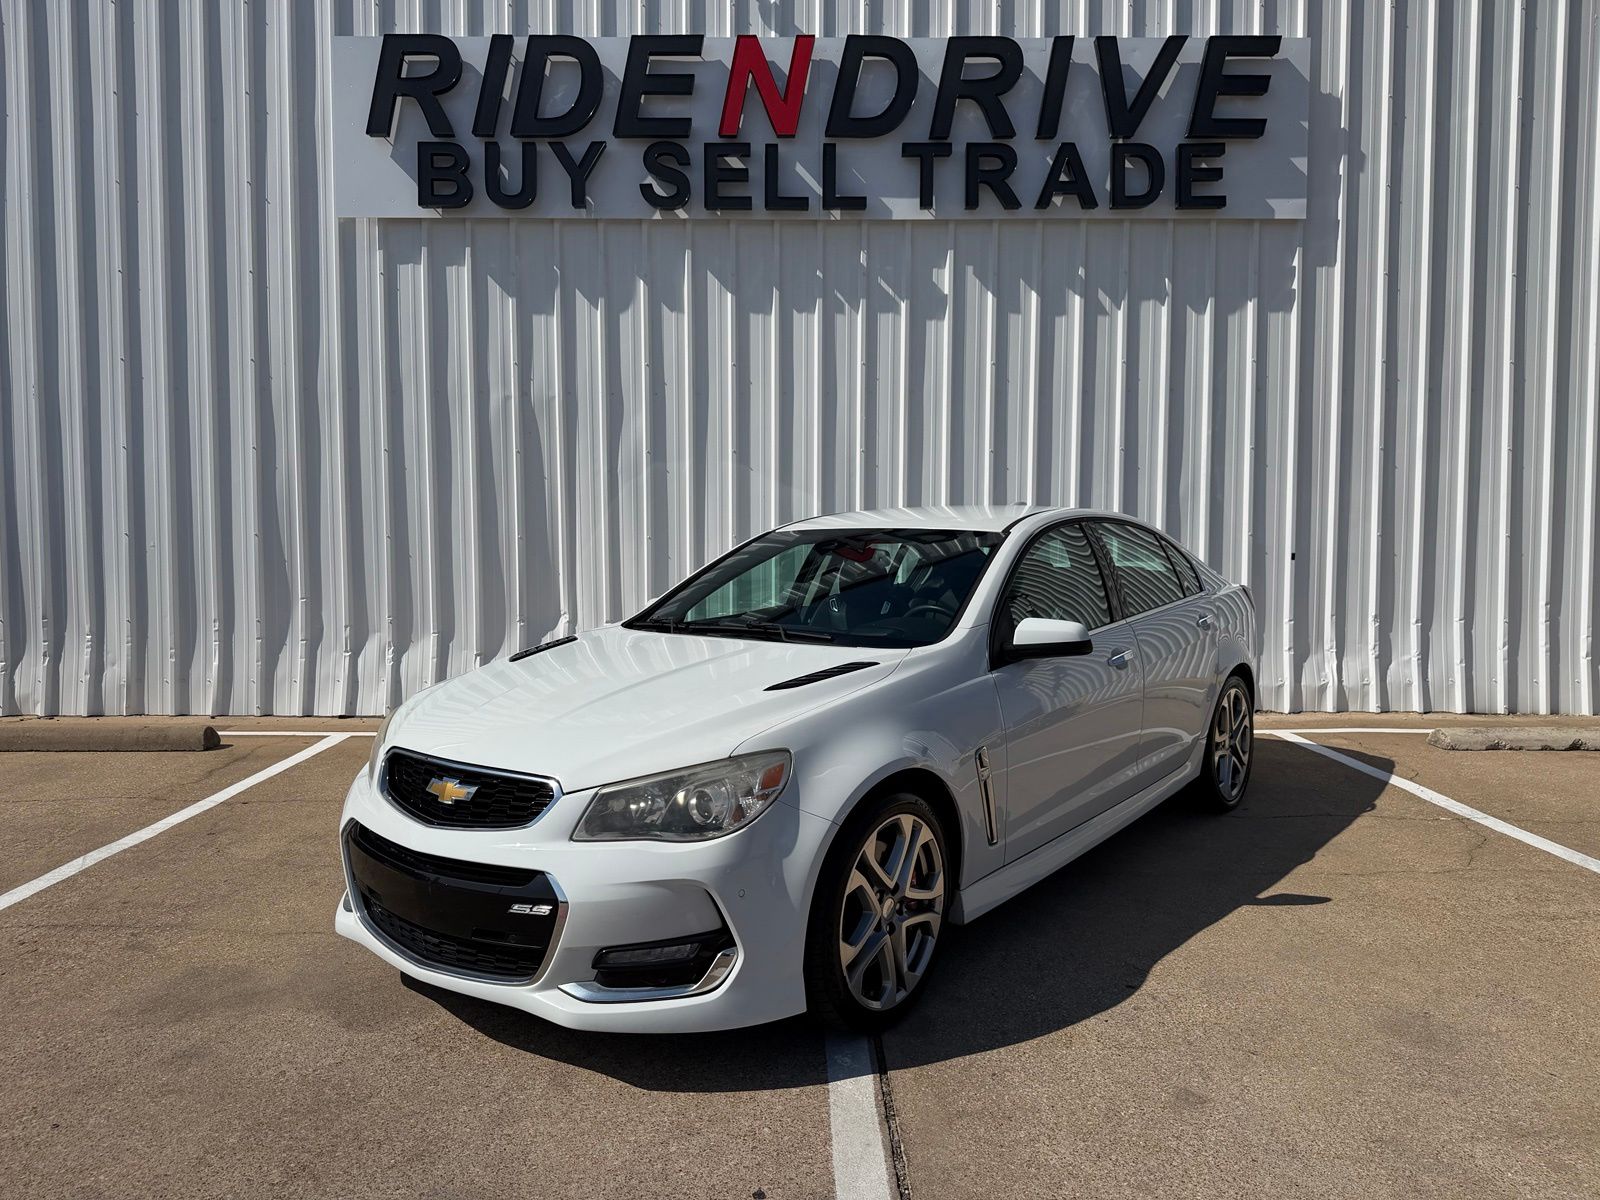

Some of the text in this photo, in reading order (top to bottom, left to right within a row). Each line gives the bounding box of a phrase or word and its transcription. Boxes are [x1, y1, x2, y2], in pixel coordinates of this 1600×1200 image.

[417, 141, 1226, 211] BUY SELL TRADE
[508, 903, 553, 916] SS
